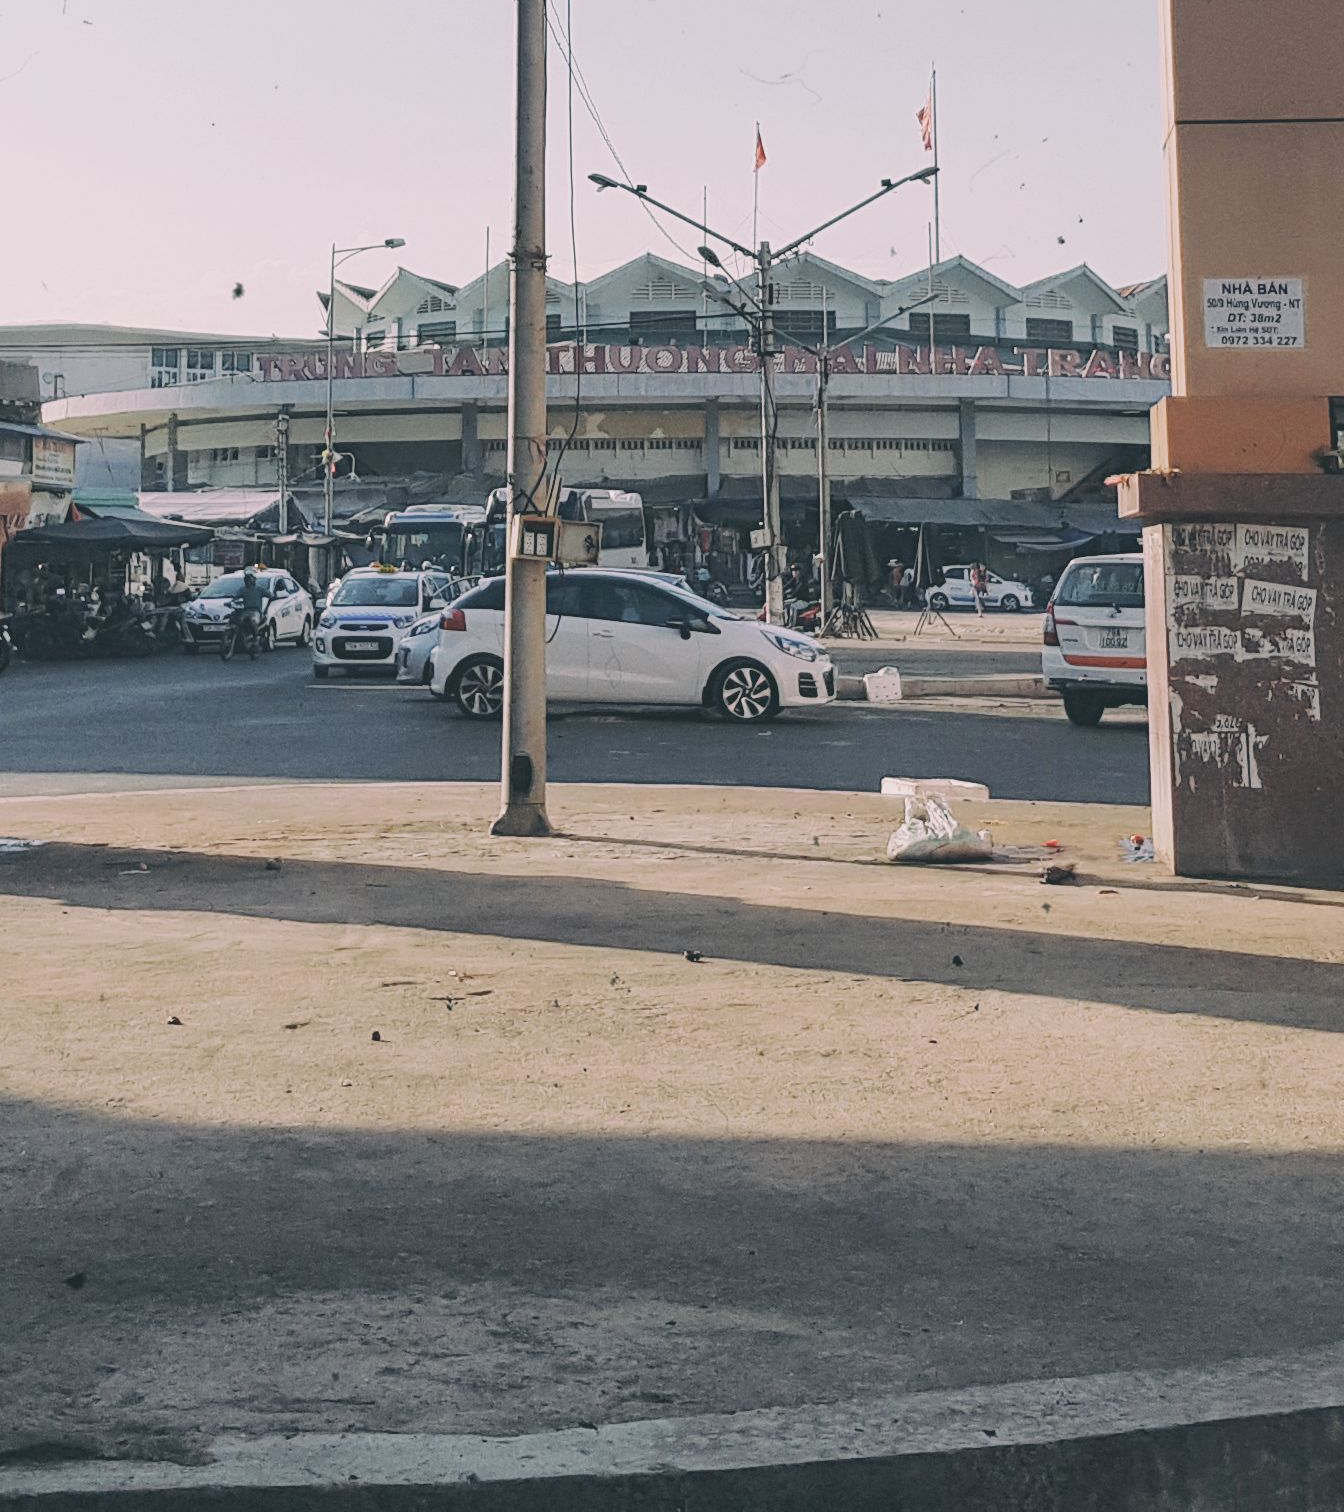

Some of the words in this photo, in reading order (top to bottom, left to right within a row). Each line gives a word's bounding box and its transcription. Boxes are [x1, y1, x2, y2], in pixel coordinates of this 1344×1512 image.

[1221, 281, 1253, 295] NHÀ
[1257, 281, 1288, 295] BÁN
[1289, 299, 1301, 309] NT
[1228, 313, 1246, 323] DT:
[1250, 313, 1281, 323] 38m2
[1221, 336, 1248, 345] 0972
[895, 344, 1004, 375] NHA
[1244, 529, 1259, 545] CHO
[1261, 530, 1274, 546] VAY
[1290, 533, 1305, 550] GÓP
[1174, 580, 1188, 598] CHO
[1220, 581, 1234, 599] GÓP
[1252, 586, 1267, 604] CHO
[1268, 589, 1282, 606] VAY
[1297, 593, 1312, 611] GÓP
[1177, 632, 1192, 648] CHO
[1193, 632, 1207, 648] VAY
[1223, 633, 1237, 649] GÓP
[1296, 635, 1310, 652] GÓP
